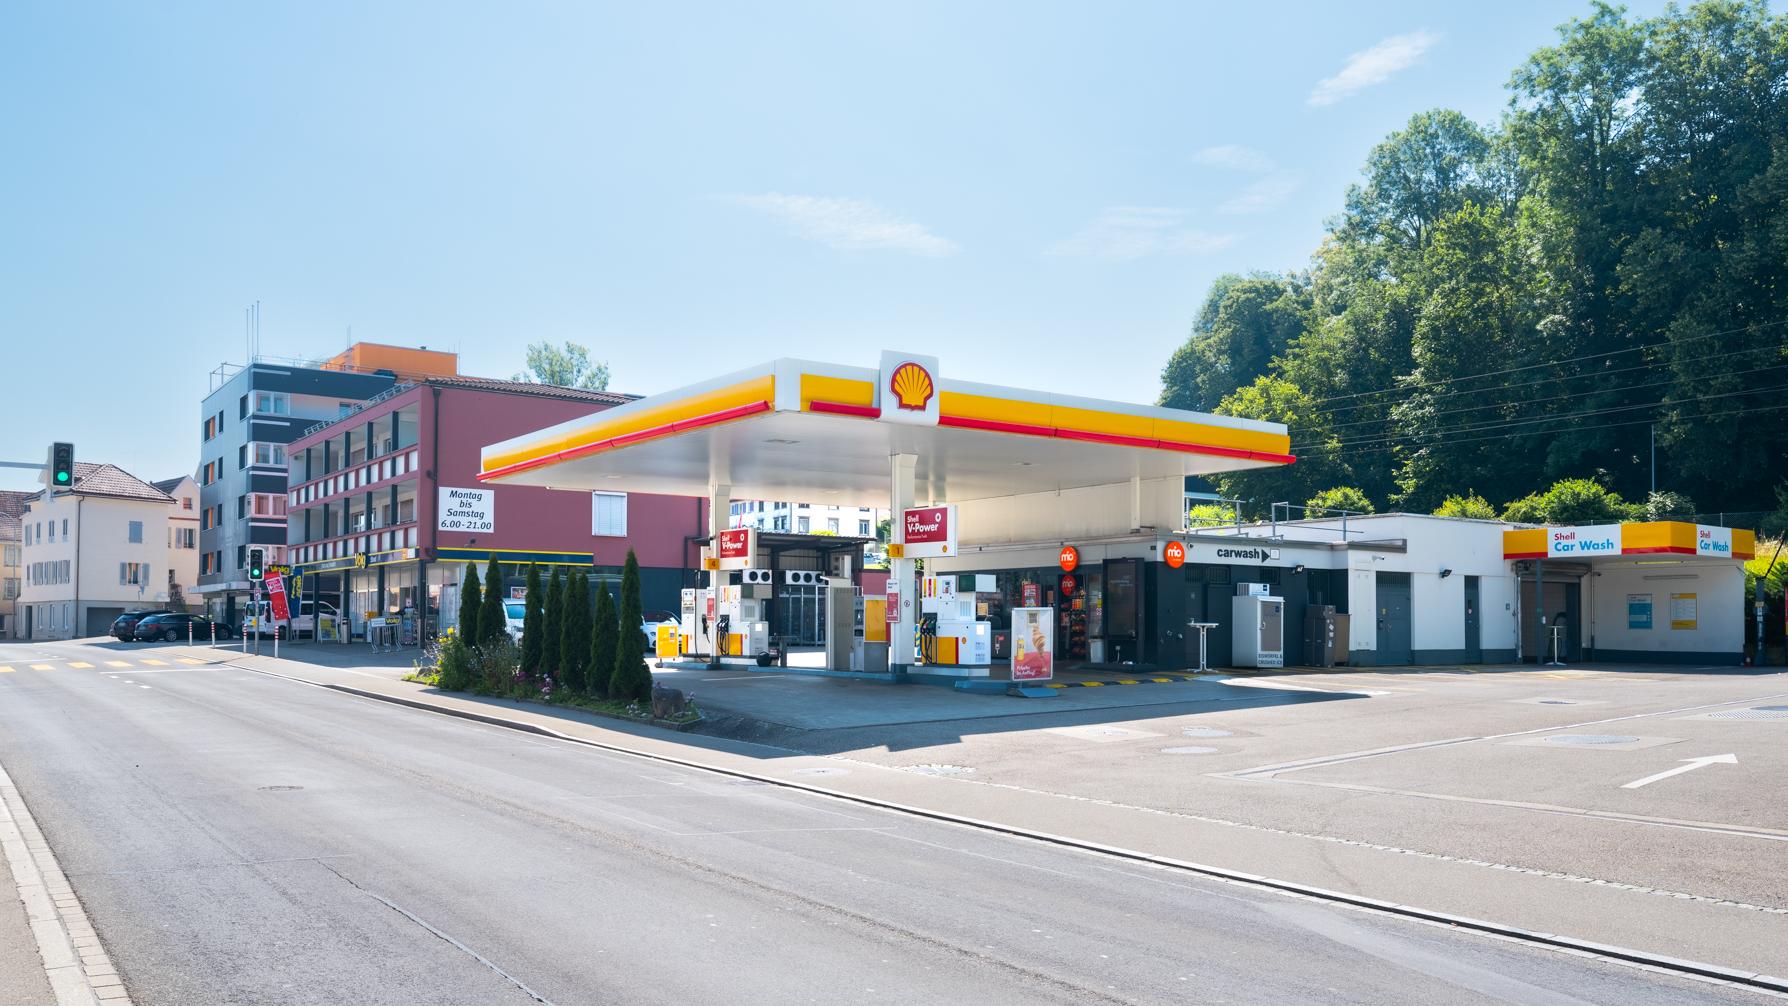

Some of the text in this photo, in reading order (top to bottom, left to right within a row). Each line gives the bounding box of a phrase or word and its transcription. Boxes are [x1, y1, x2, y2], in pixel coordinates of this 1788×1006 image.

[449, 490, 483, 502] Montag
[459, 499, 473, 509] bis
[446, 508, 485, 520] Samstag
[907, 514, 920, 523] Shell
[440, 519, 462, 529] 6.00
[466, 520, 492, 530] 21.00
[907, 522, 939, 534] V-Power
[1554, 532, 1576, 541] Shell
[1700, 530, 1711, 538] Shell
[721, 541, 744, 550] V-Power
[1554, 538, 1614, 552] Car Wash
[1700, 539, 1729, 552] Car Wash
[1061, 551, 1074, 562] mio
[1167, 546, 1182, 557] mio
[1217, 548, 1260, 560] carwash
